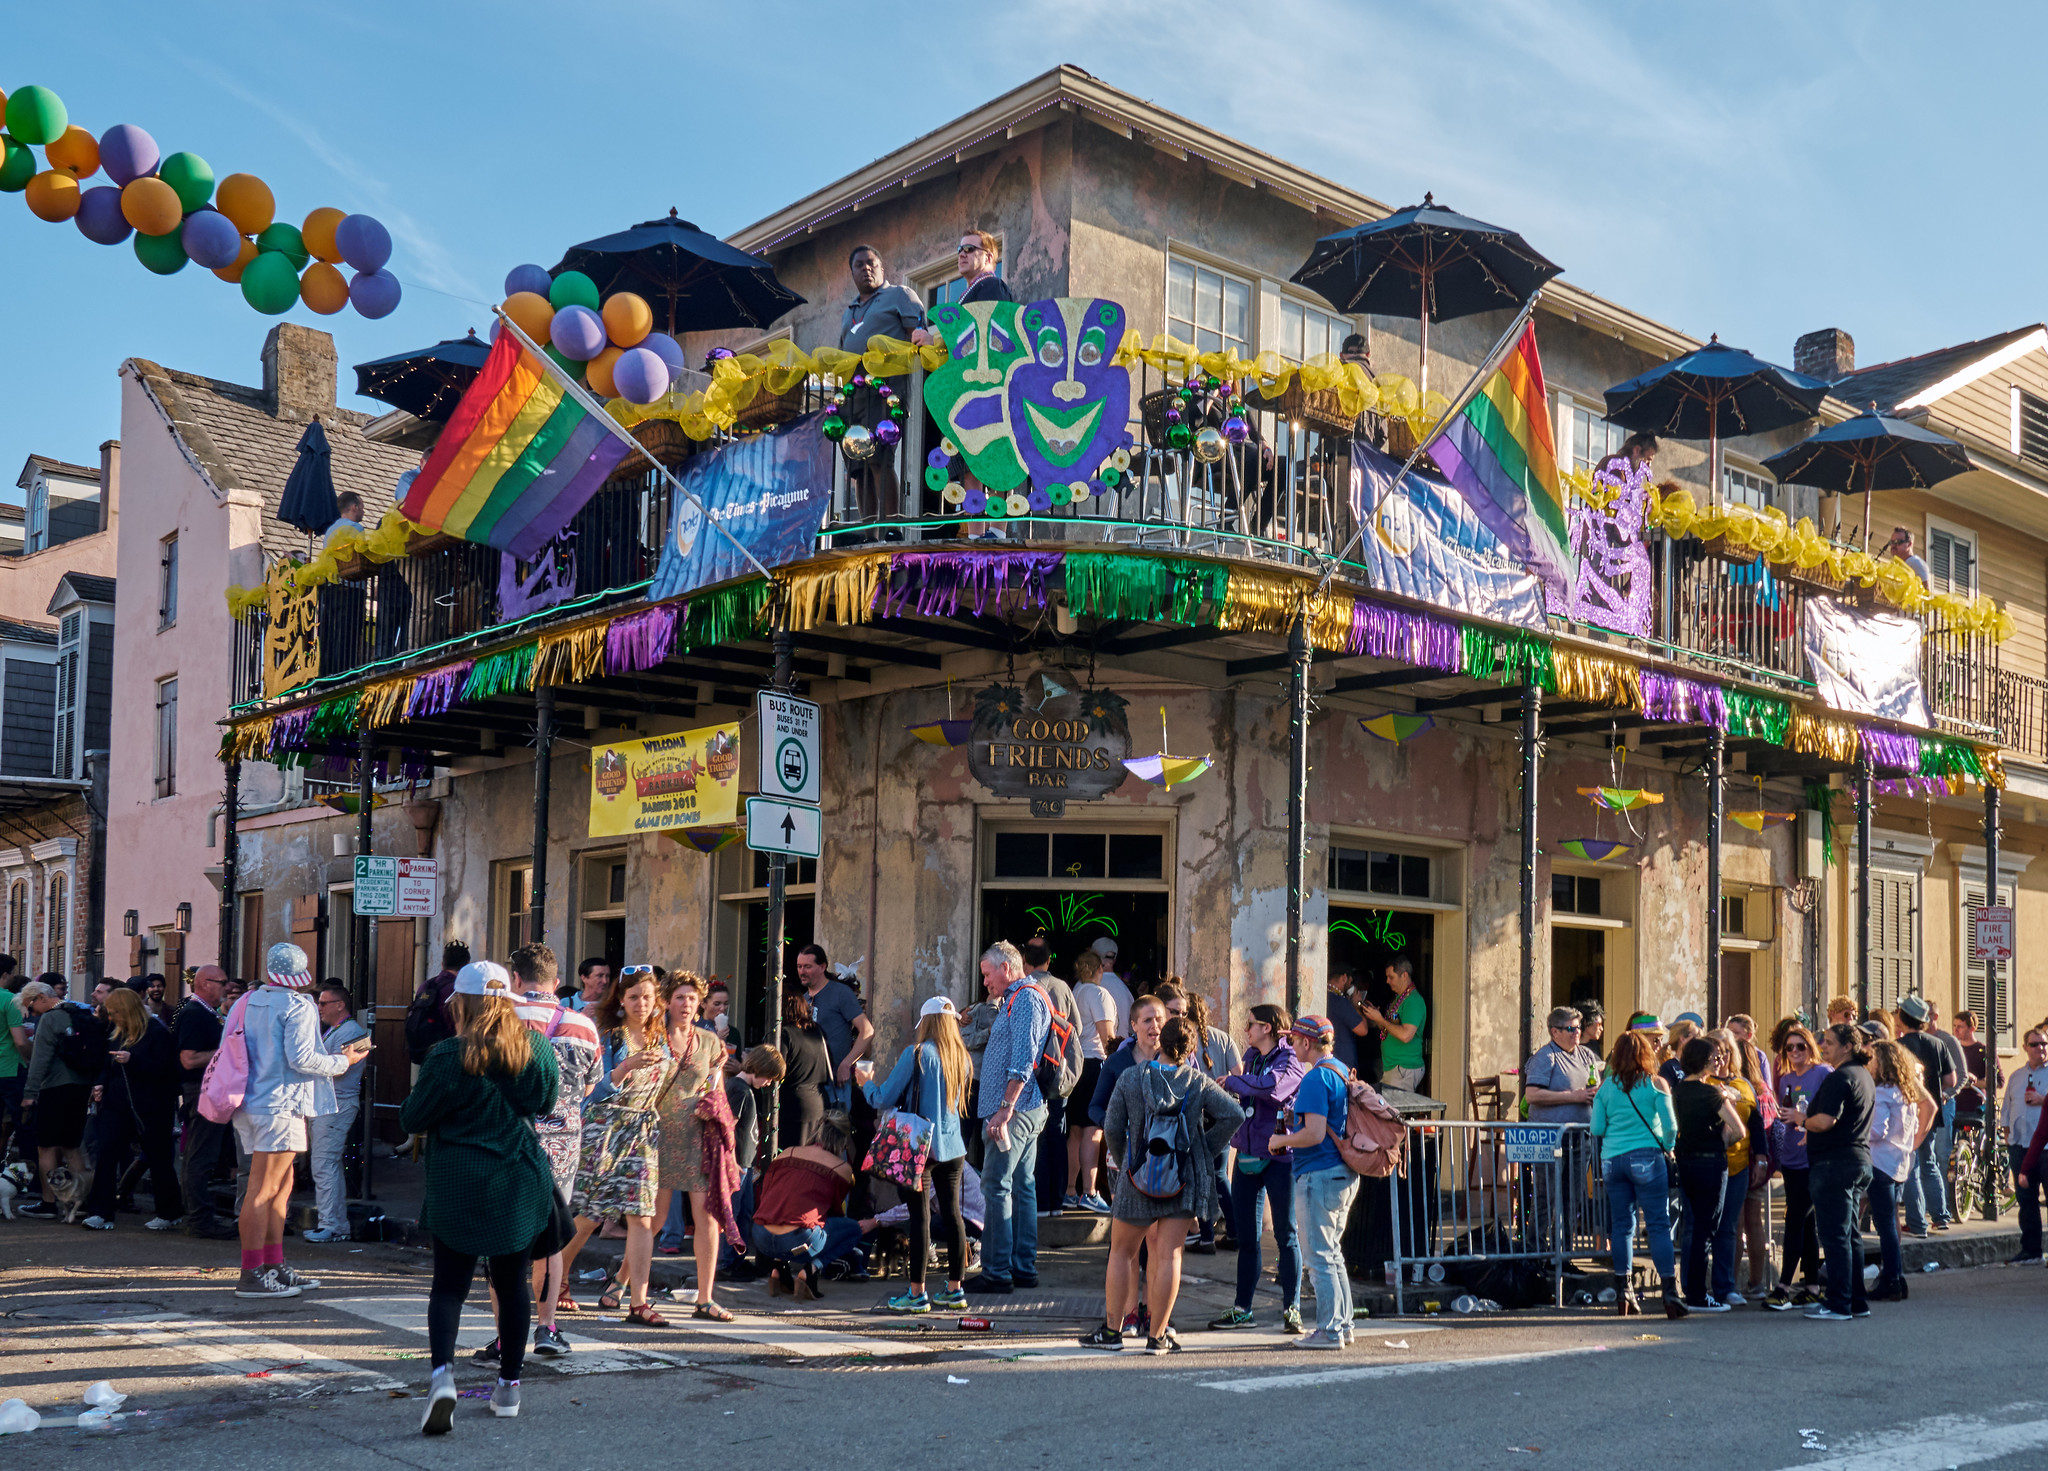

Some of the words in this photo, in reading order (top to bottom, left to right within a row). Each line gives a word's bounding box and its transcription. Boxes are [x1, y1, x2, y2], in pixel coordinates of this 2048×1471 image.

[726, 488, 809, 520] Times-Picayune
[769, 699, 787, 713] BUS
[789, 703, 813, 720] ROUTE
[776, 713, 793, 725] BUSES
[801, 719, 808, 728] FT
[776, 724, 790, 734] AND
[791, 727, 808, 738] UNDER
[1012, 718, 1090, 744] GOOD
[641, 735, 687, 754] WELCOME
[712, 753, 733, 763] GOOD
[988, 743, 1111, 771] FRIENDS
[602, 770, 621, 780] GOOD
[709, 763, 737, 773] FRIENDS
[598, 778, 625, 788] FRIENDS
[1028, 772, 1069, 788] BAR
[673, 795, 697, 810] 2018
[634, 815, 660, 829] GAME
[660, 815, 672, 827] OF
[673, 811, 701, 825] BONES
[357, 860, 366, 875] 2
[376, 860, 387, 868] HR
[369, 868, 394, 877] PARKING
[398, 862, 410, 874] NO
[409, 865, 437, 873] PARKING
[402, 904, 431, 912] ANYTIME
[1976, 909, 1988, 920] NO
[1984, 924, 2003, 933] FIRE
[1982, 935, 2005, 944] LANE
